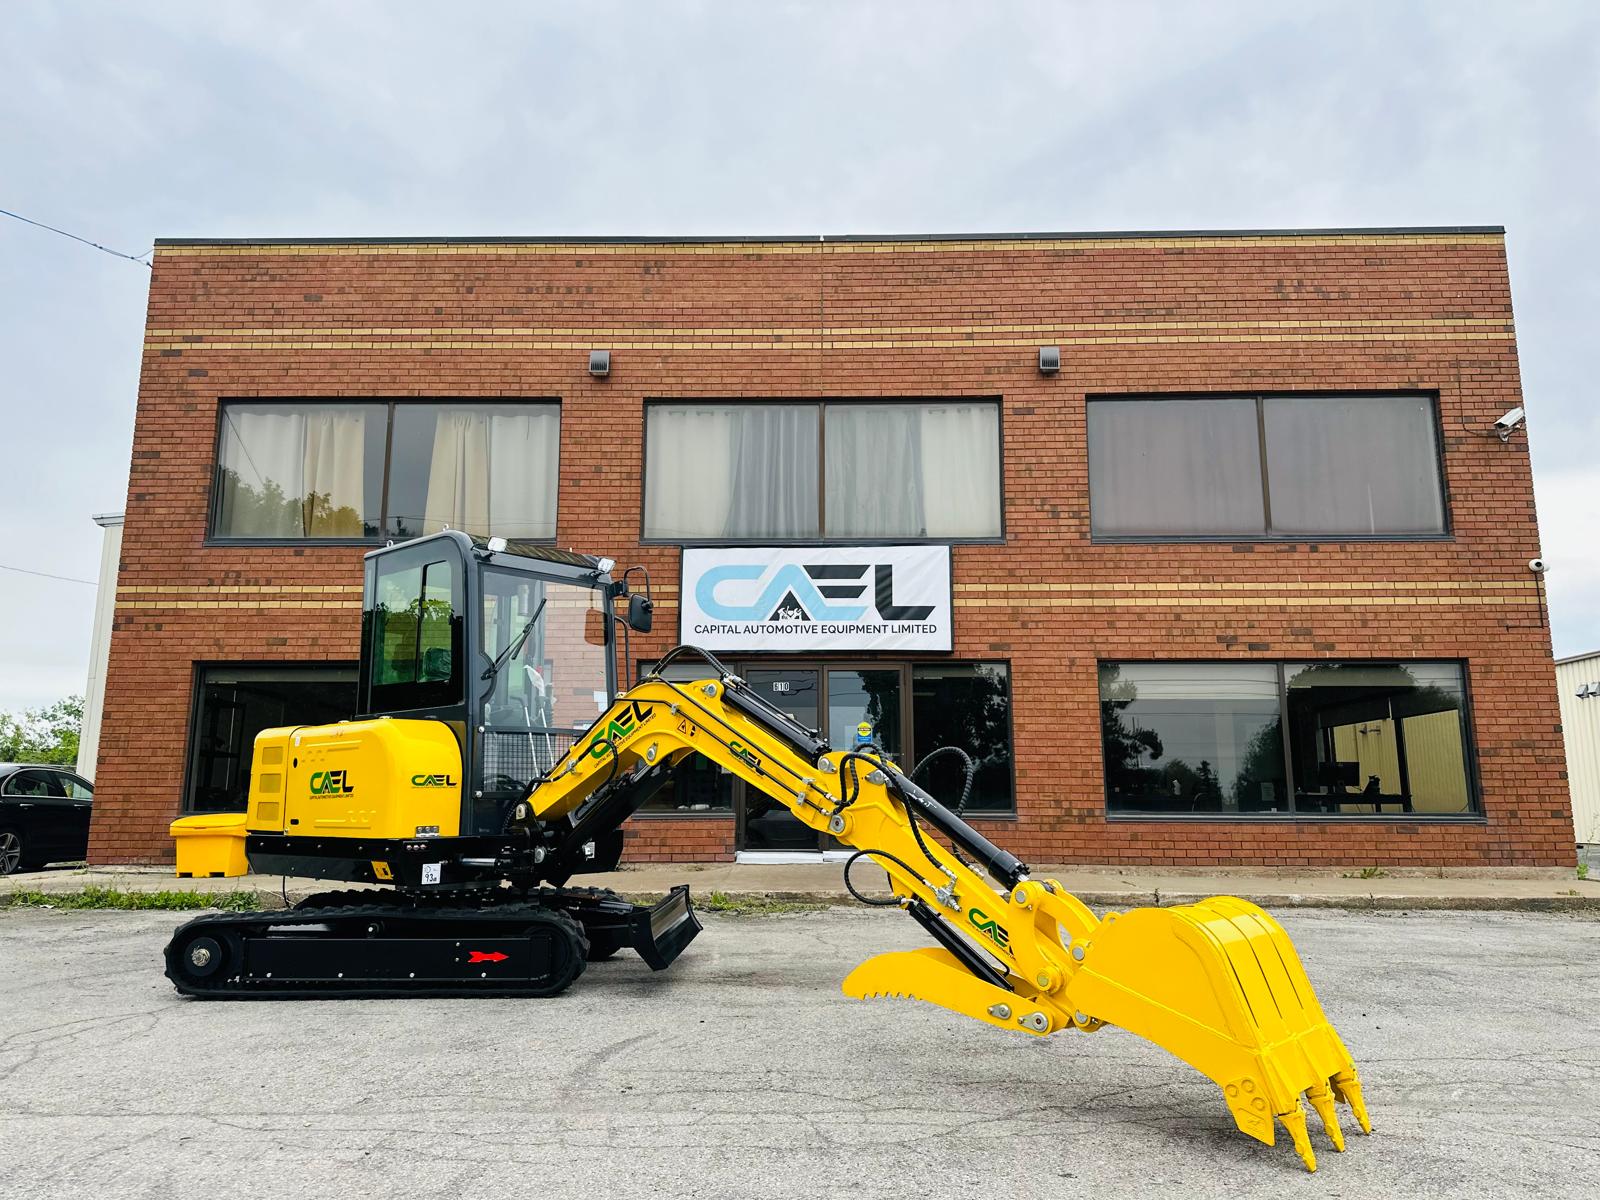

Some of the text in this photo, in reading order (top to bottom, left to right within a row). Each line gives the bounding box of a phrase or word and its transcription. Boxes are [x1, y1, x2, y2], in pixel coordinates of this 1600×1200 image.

[695, 564, 936, 621] CAEL
[694, 624, 937, 634] CAPITAL AUTOMOTIVE EQUIPMENT LIMITED
[641, 712, 657, 726] LIMITED
[310, 770, 354, 794] CAEL
[412, 775, 457, 786] CAEL
